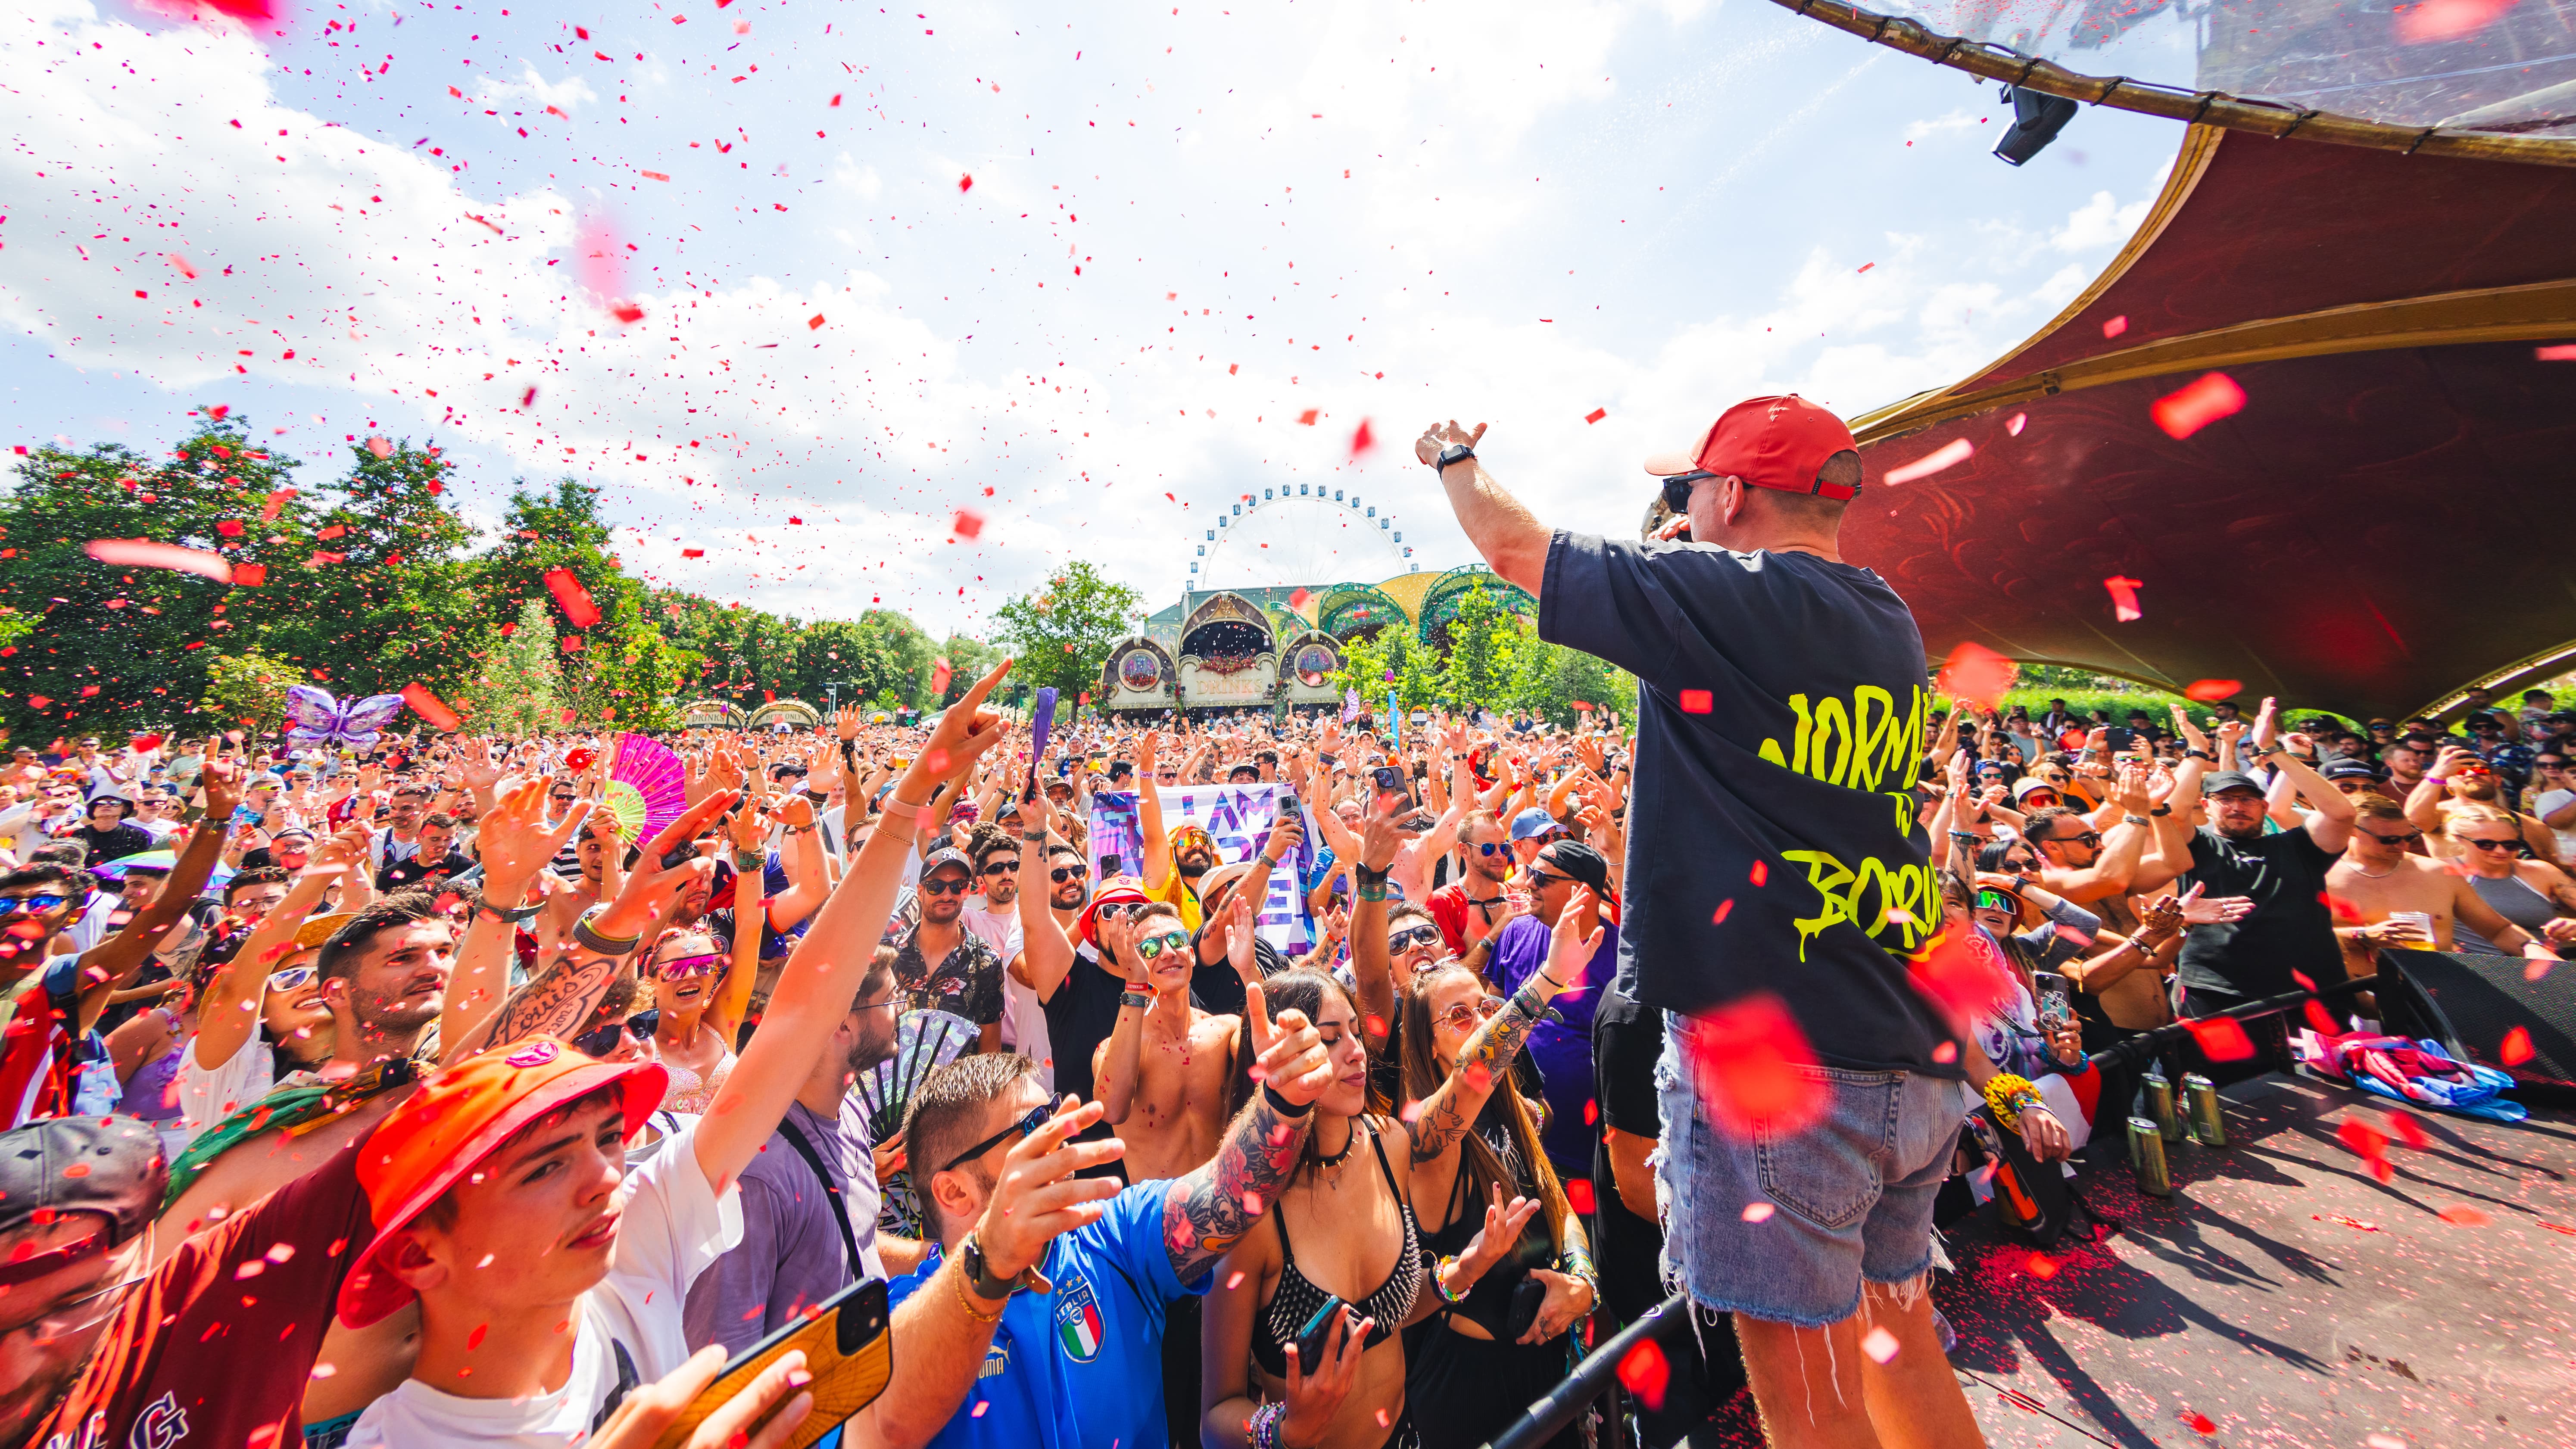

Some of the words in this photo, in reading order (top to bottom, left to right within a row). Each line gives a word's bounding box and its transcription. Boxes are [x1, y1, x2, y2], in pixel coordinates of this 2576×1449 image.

[1196, 679, 1263, 695] DRINKS
[1207, 786, 1273, 835] AM
[942, 848, 957, 860] NY
[1056, 1290, 1088, 1321] ITALIA
[979, 1357, 1004, 1379] UMA
